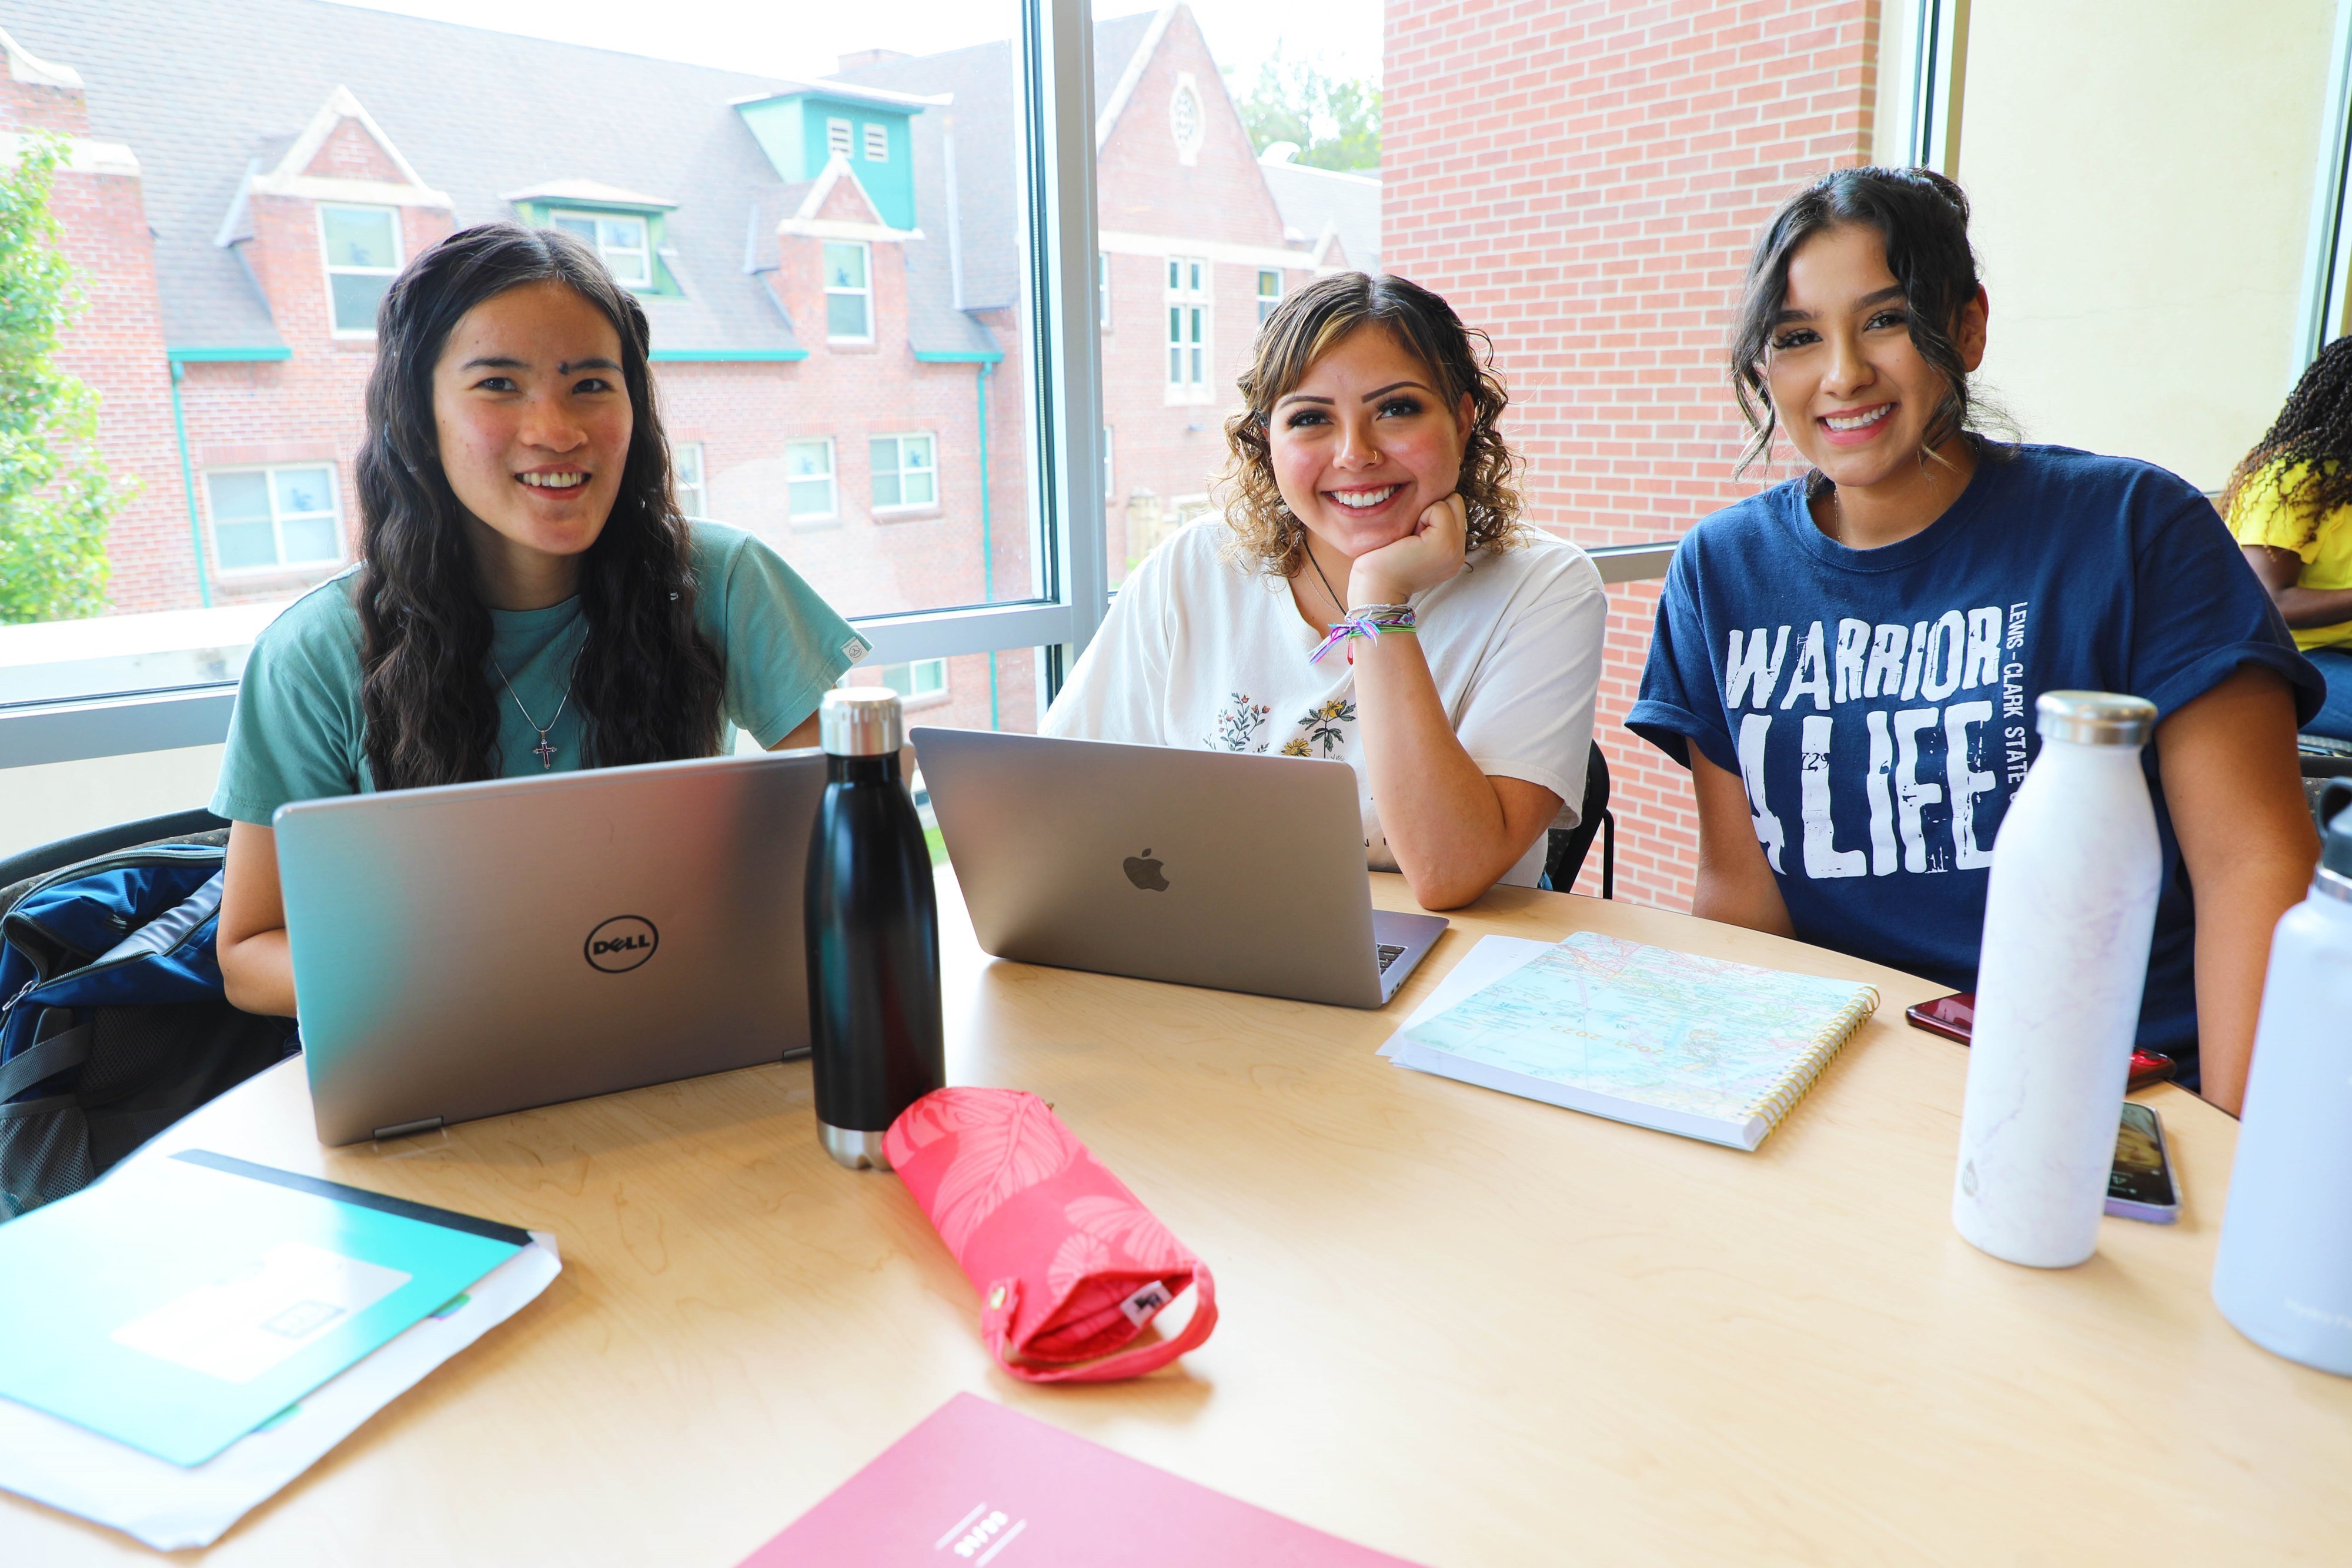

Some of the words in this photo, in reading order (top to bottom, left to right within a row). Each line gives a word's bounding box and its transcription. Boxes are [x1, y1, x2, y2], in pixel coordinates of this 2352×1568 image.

[1726, 606, 2002, 710] WARRIOR
[2004, 726, 2028, 784] STATE
[593, 934, 650, 955] DELL
[1549, 1025, 1603, 1040] 2022
